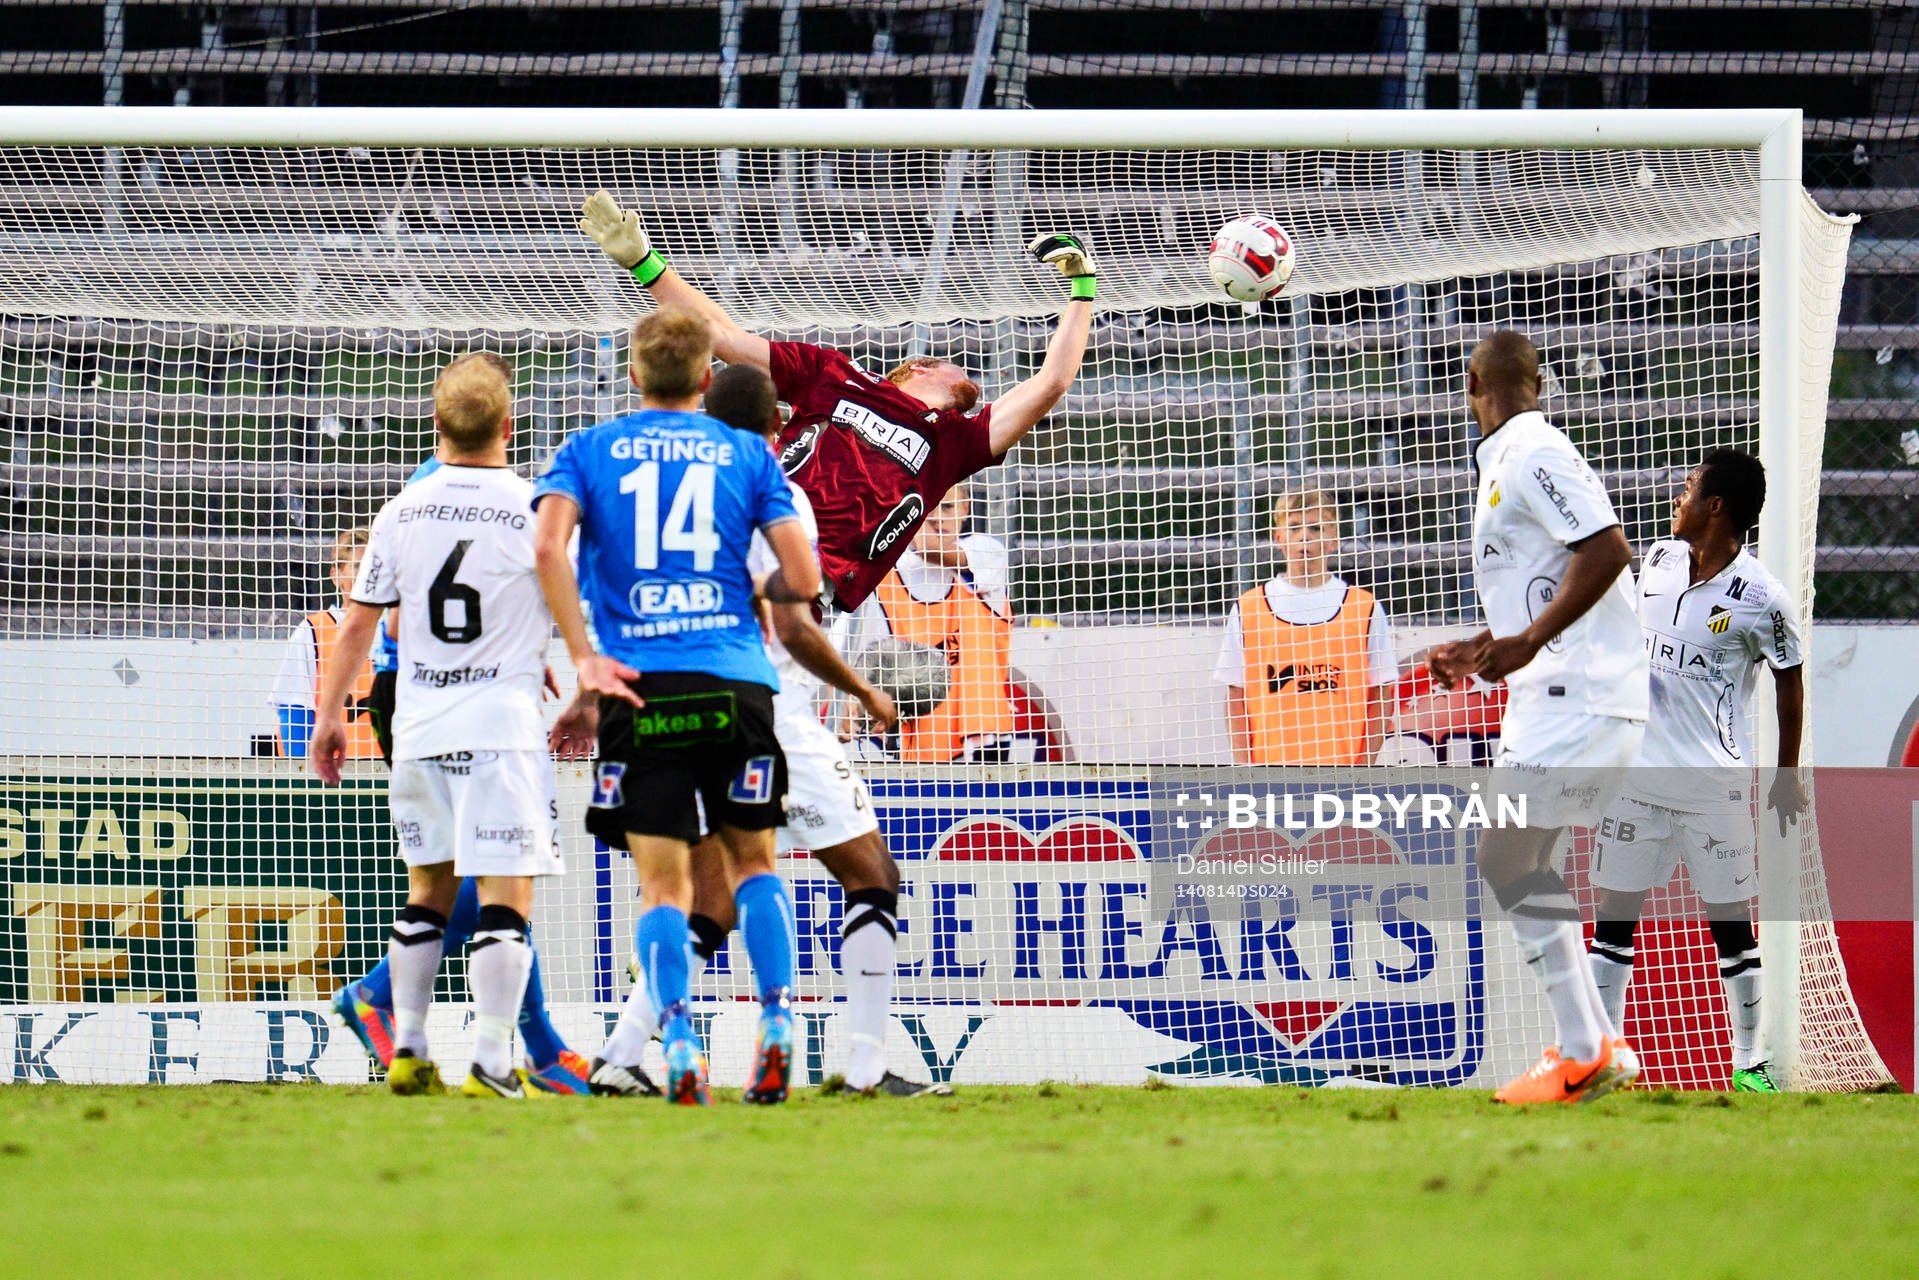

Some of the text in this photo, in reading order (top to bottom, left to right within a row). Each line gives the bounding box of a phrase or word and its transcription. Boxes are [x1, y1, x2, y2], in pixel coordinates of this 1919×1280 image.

[609, 436, 735, 467] GETINGE
[398, 504, 528, 531] EHRENBORG
[619, 460, 721, 572] 14
[1533, 467, 1580, 531] stadium
[877, 505, 919, 552] BOHUS
[428, 539, 482, 644] 6
[638, 581, 717, 615] EAB
[1770, 610, 1788, 663] stadium
[411, 661, 501, 688] Tingstad
[638, 711, 702, 736] akea
